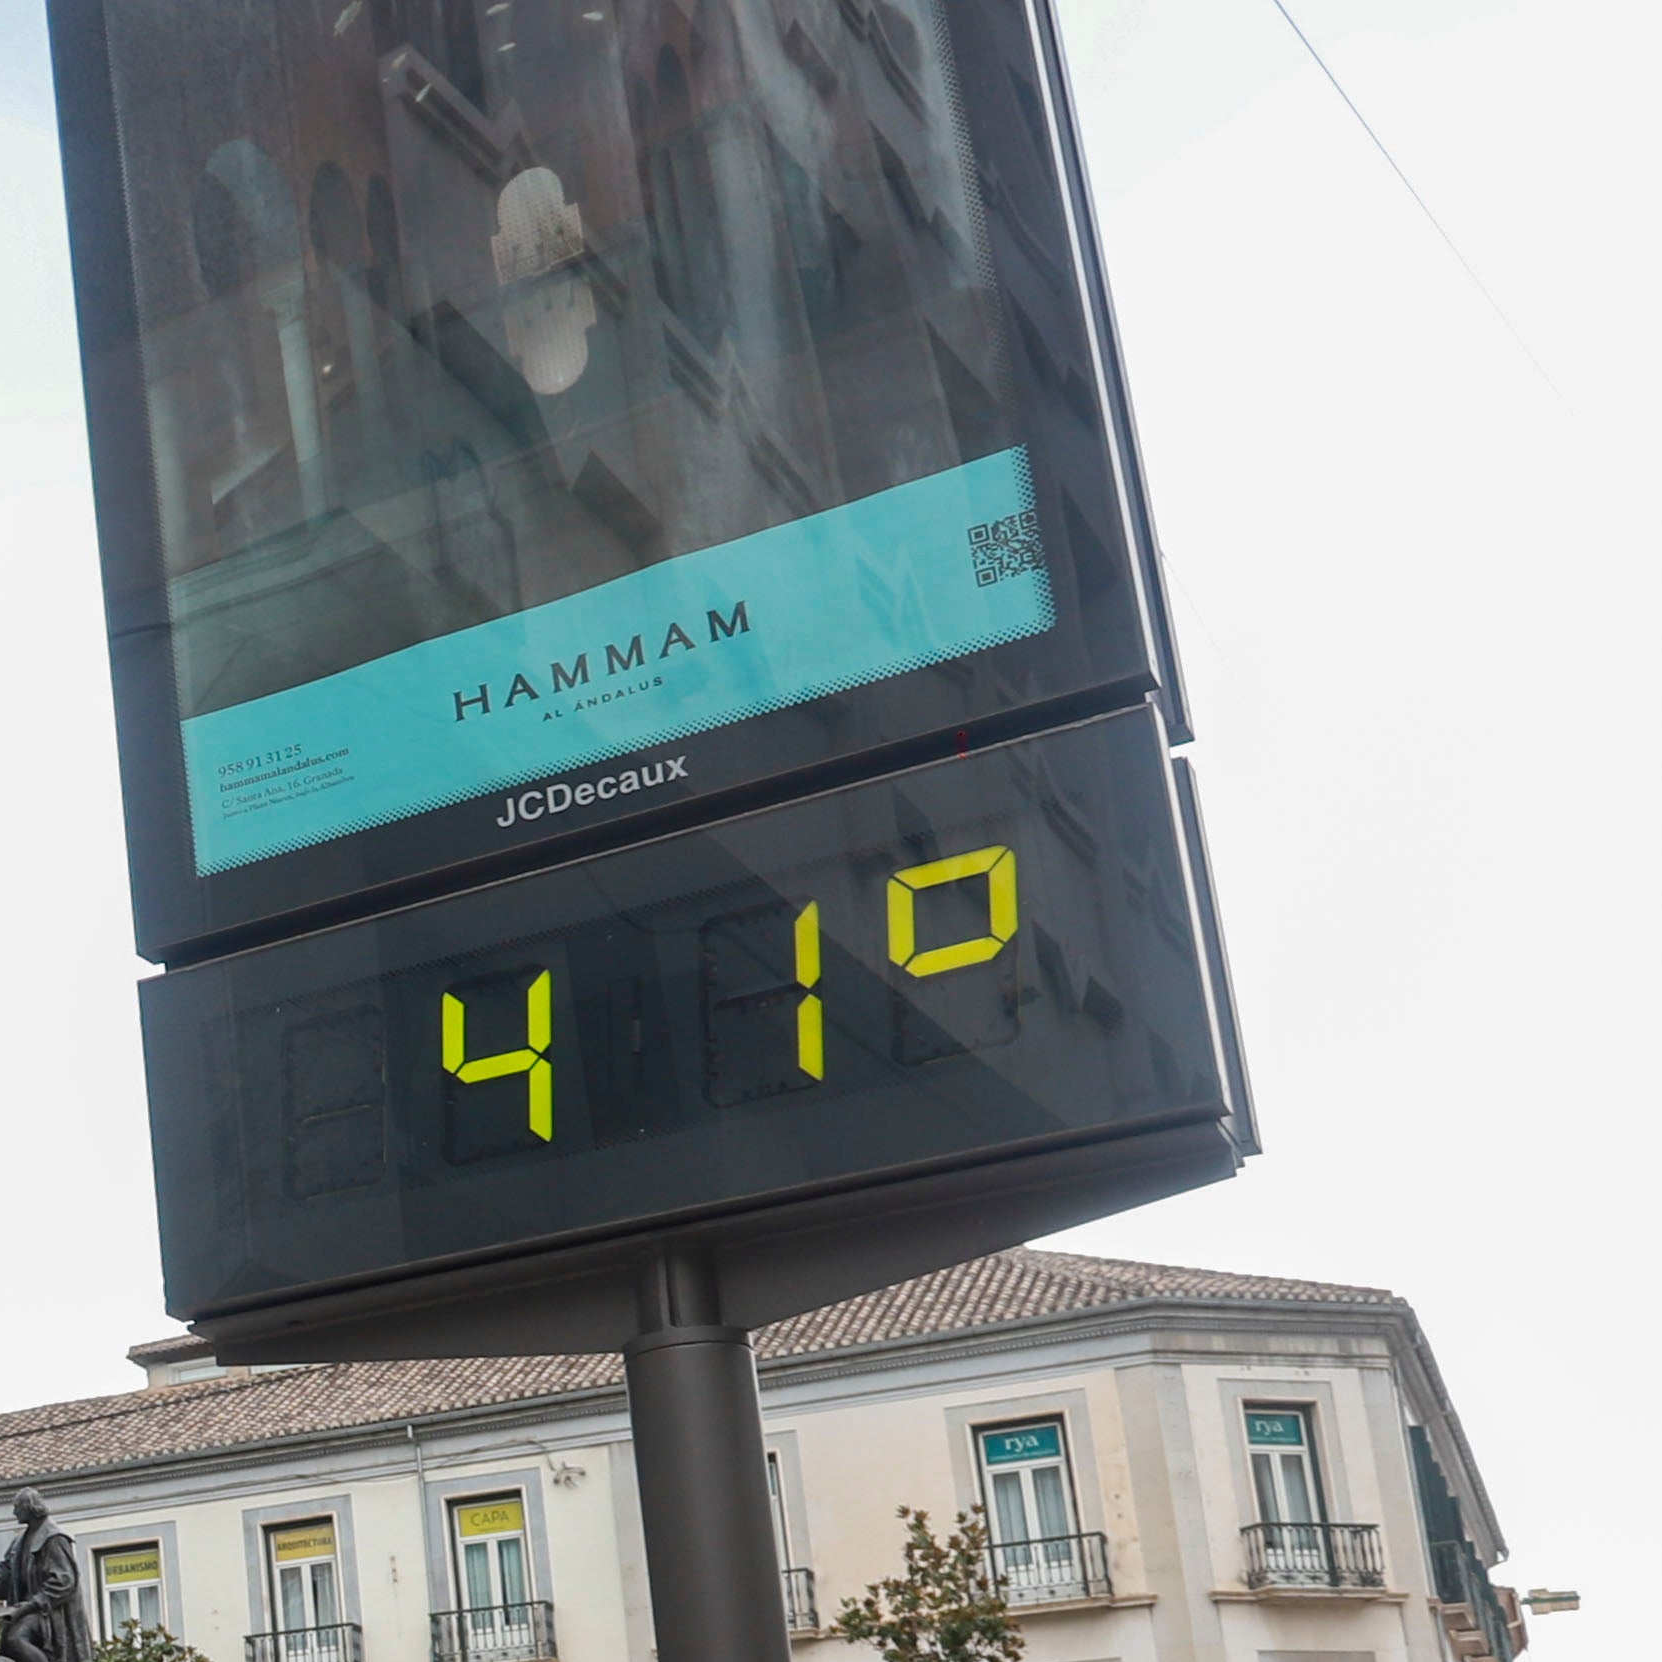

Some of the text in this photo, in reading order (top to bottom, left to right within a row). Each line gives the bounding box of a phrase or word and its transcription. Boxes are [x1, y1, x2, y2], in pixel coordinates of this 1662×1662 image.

[453, 600, 751, 722] HAMMAM
[542, 709, 563, 722] AL
[218, 744, 302, 778] 958 91 31 25
[496, 755, 689, 828] JCDecaux
[1255, 1420, 1285, 1436] rya
[1004, 1435, 1039, 1453] rya
[470, 1510, 510, 1527] CAPA
[277, 1537, 334, 1552] ARQUITECTURA
[105, 1560, 159, 1577] URBANISMO
